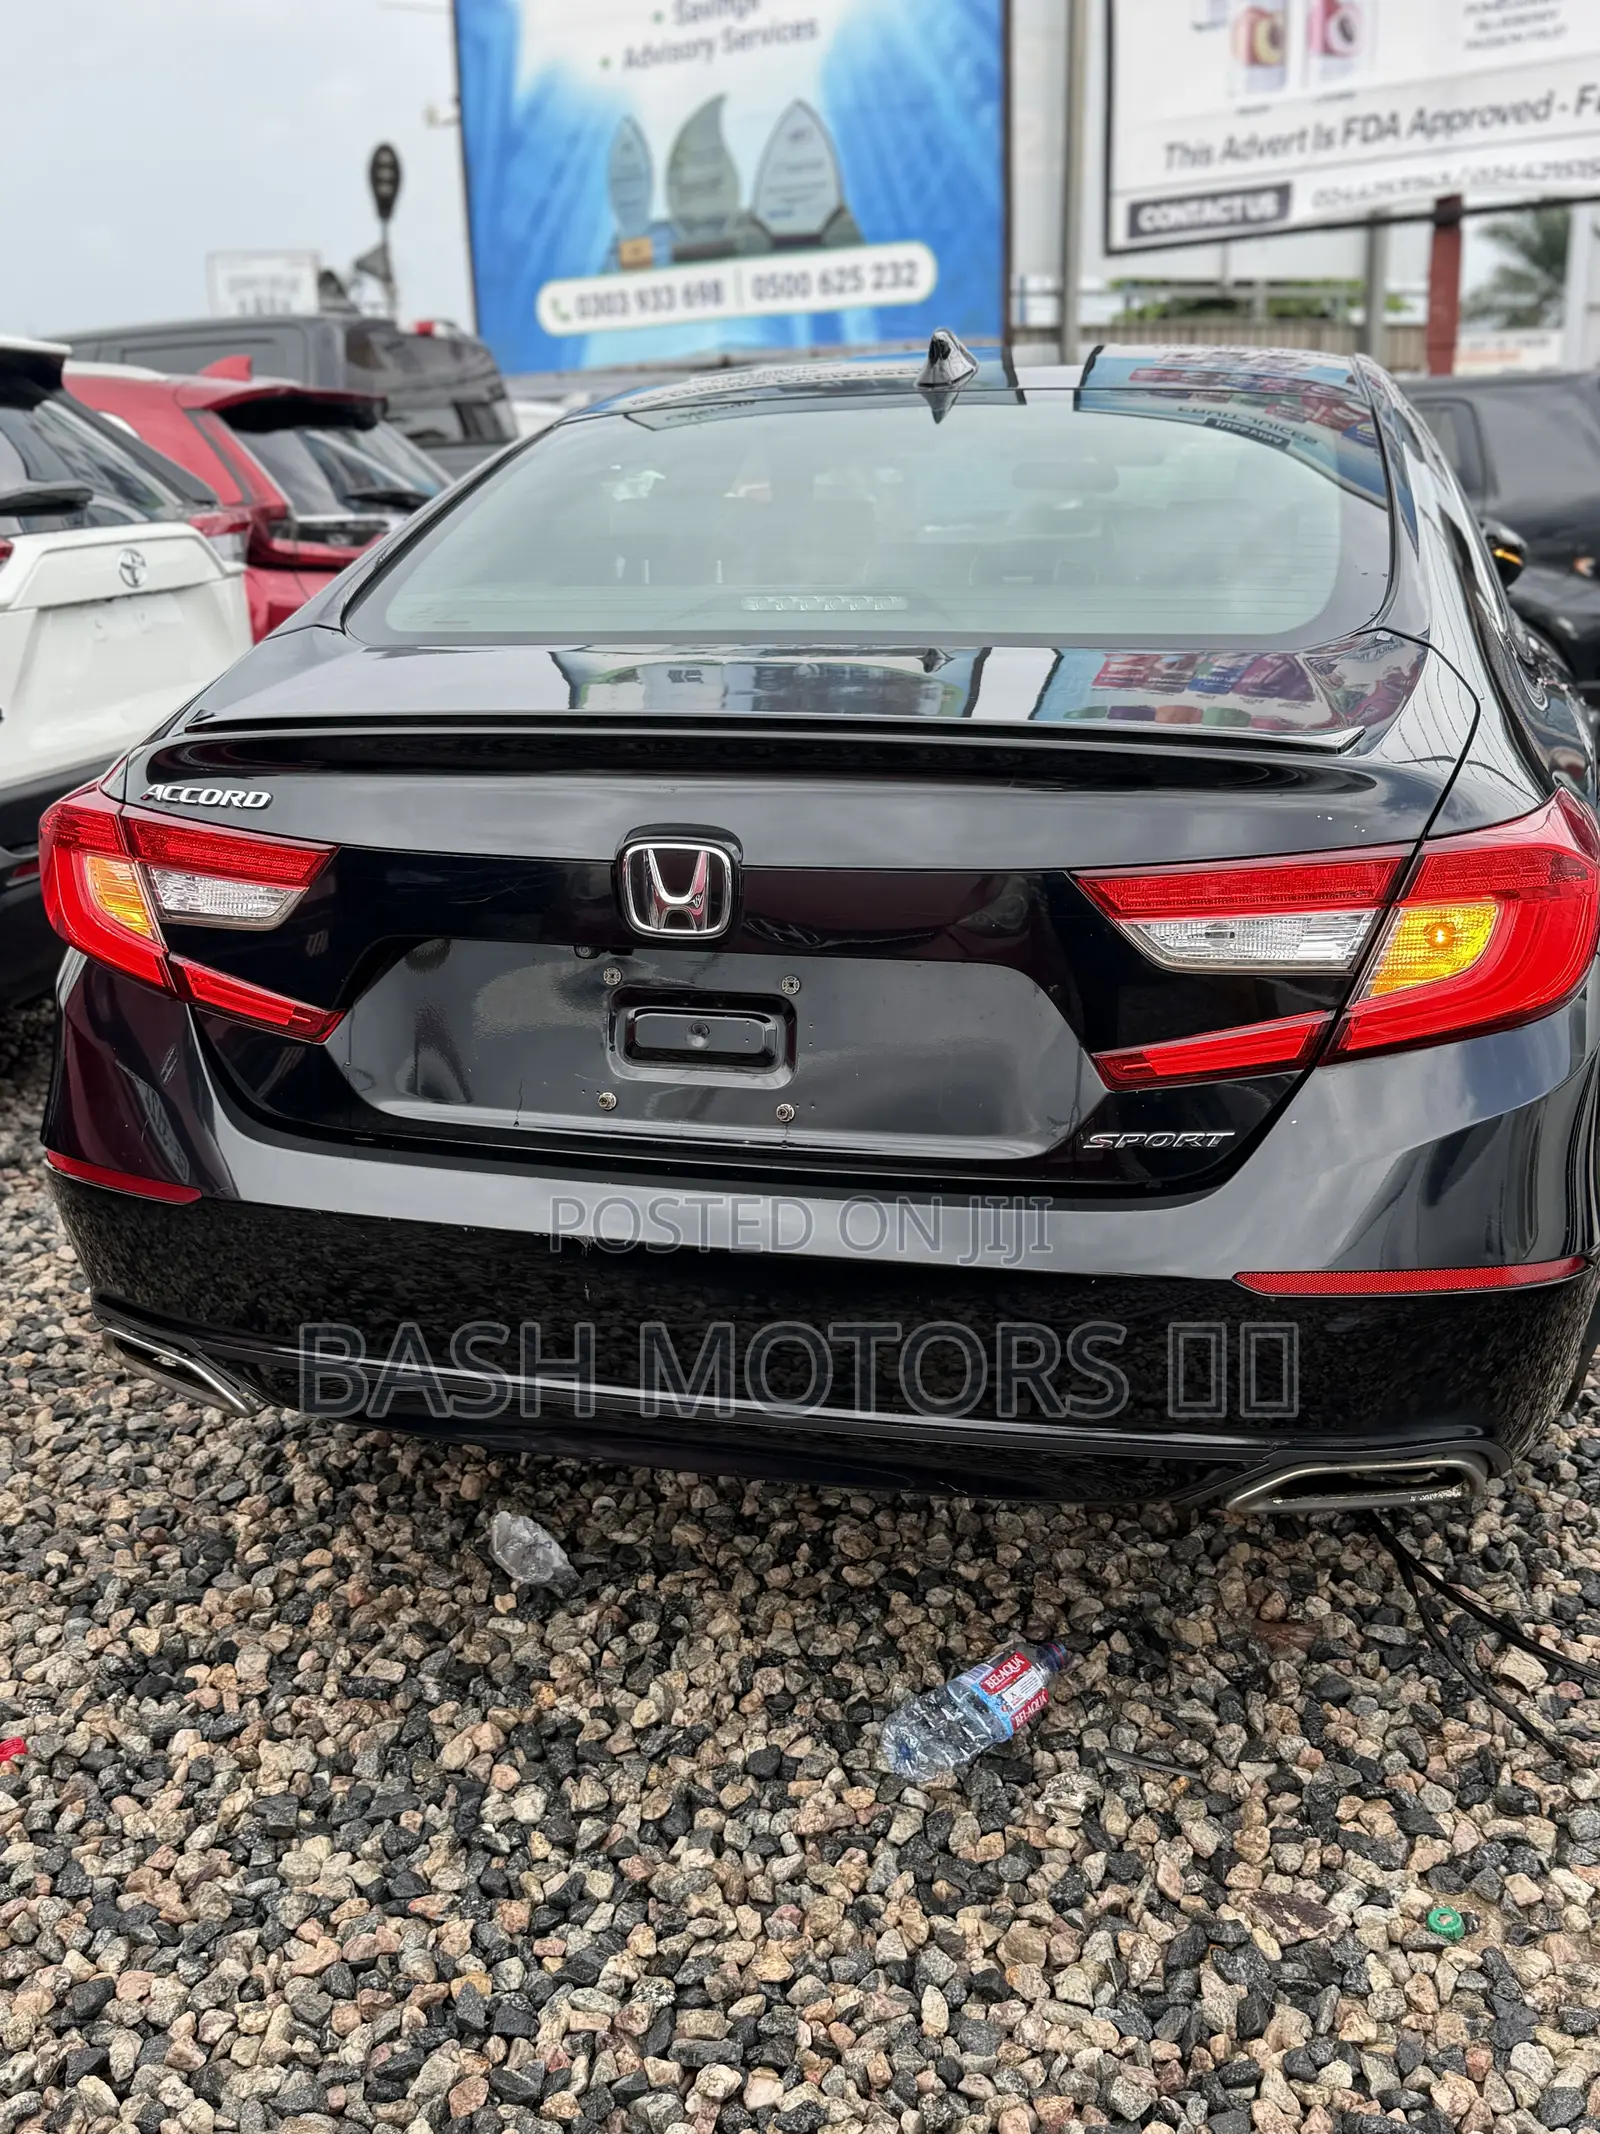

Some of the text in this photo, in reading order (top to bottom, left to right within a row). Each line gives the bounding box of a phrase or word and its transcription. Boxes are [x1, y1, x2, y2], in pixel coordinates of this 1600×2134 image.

[622, 18, 818, 69] Advisory Services
[1163, 141, 1214, 171] This
[1218, 127, 1307, 164] Advert
[1341, 111, 1401, 147] FDA
[1407, 89, 1556, 142] Approved
[870, 260, 920, 290] 232
[140, 783, 273, 809] ACCORD
[1083, 1131, 1236, 1149] SPORT
